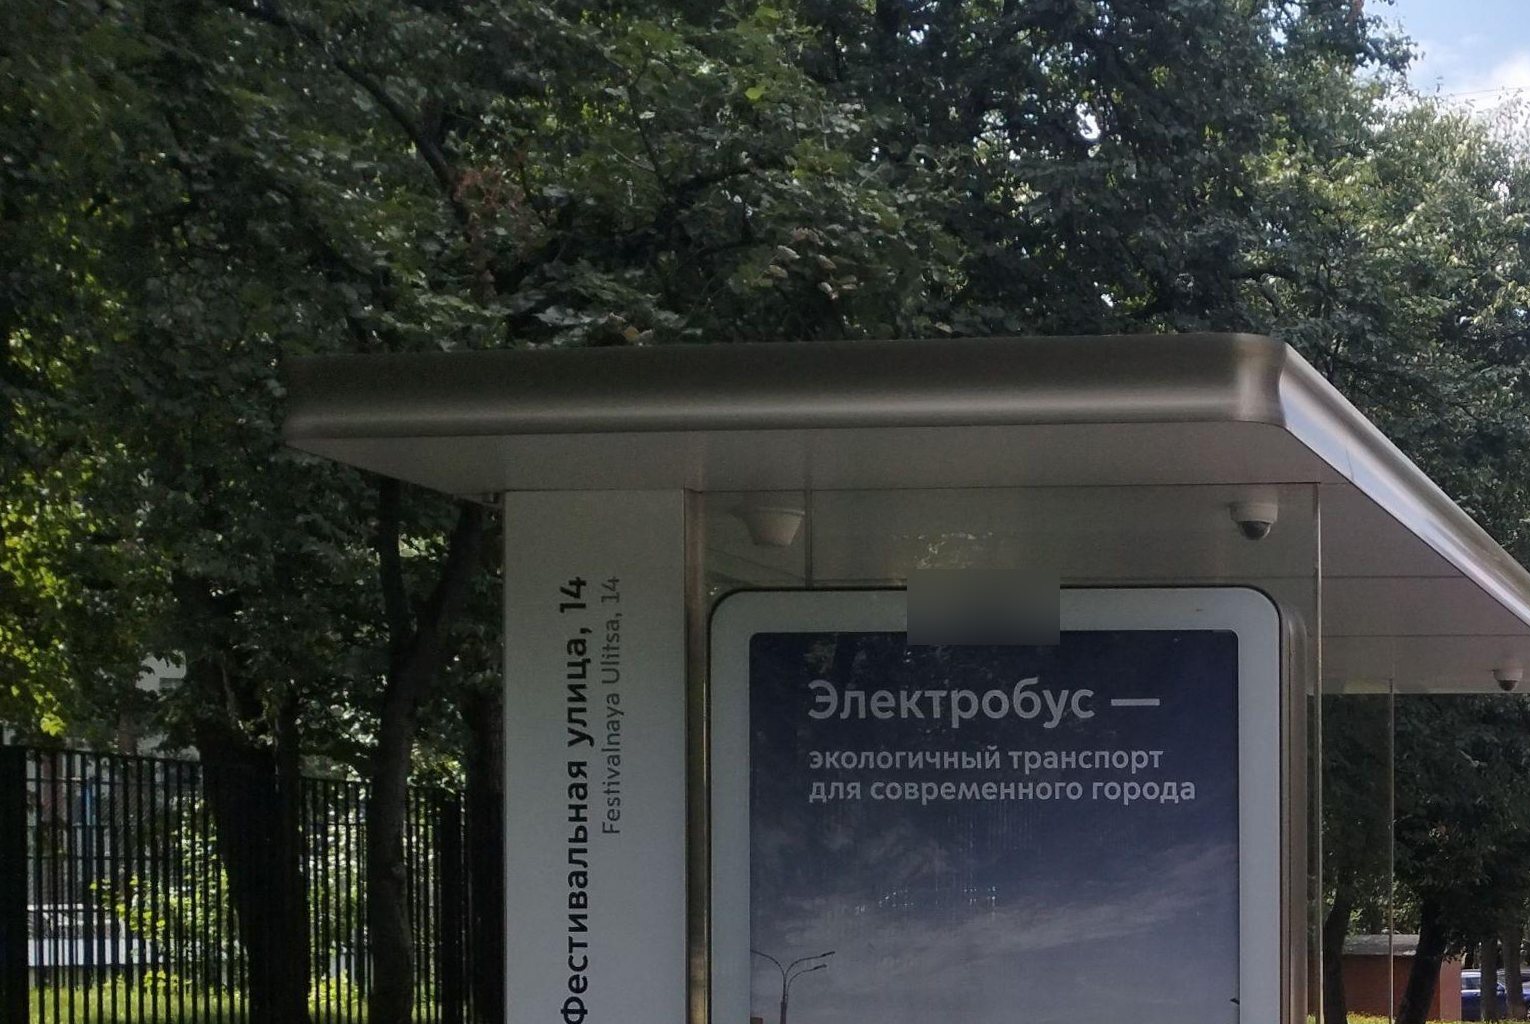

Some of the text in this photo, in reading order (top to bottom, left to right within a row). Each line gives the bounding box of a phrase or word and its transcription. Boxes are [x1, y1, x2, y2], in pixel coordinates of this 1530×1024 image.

[559, 576, 587, 614] 14
[566, 627, 595, 747] улица,
[600, 576, 625, 834] Festivalnaya Ulitsa, 14
[808, 677, 1096, 729] Электробус
[809, 745, 1164, 775] экологичный транспорт
[809, 781, 1196, 806] для современного города
